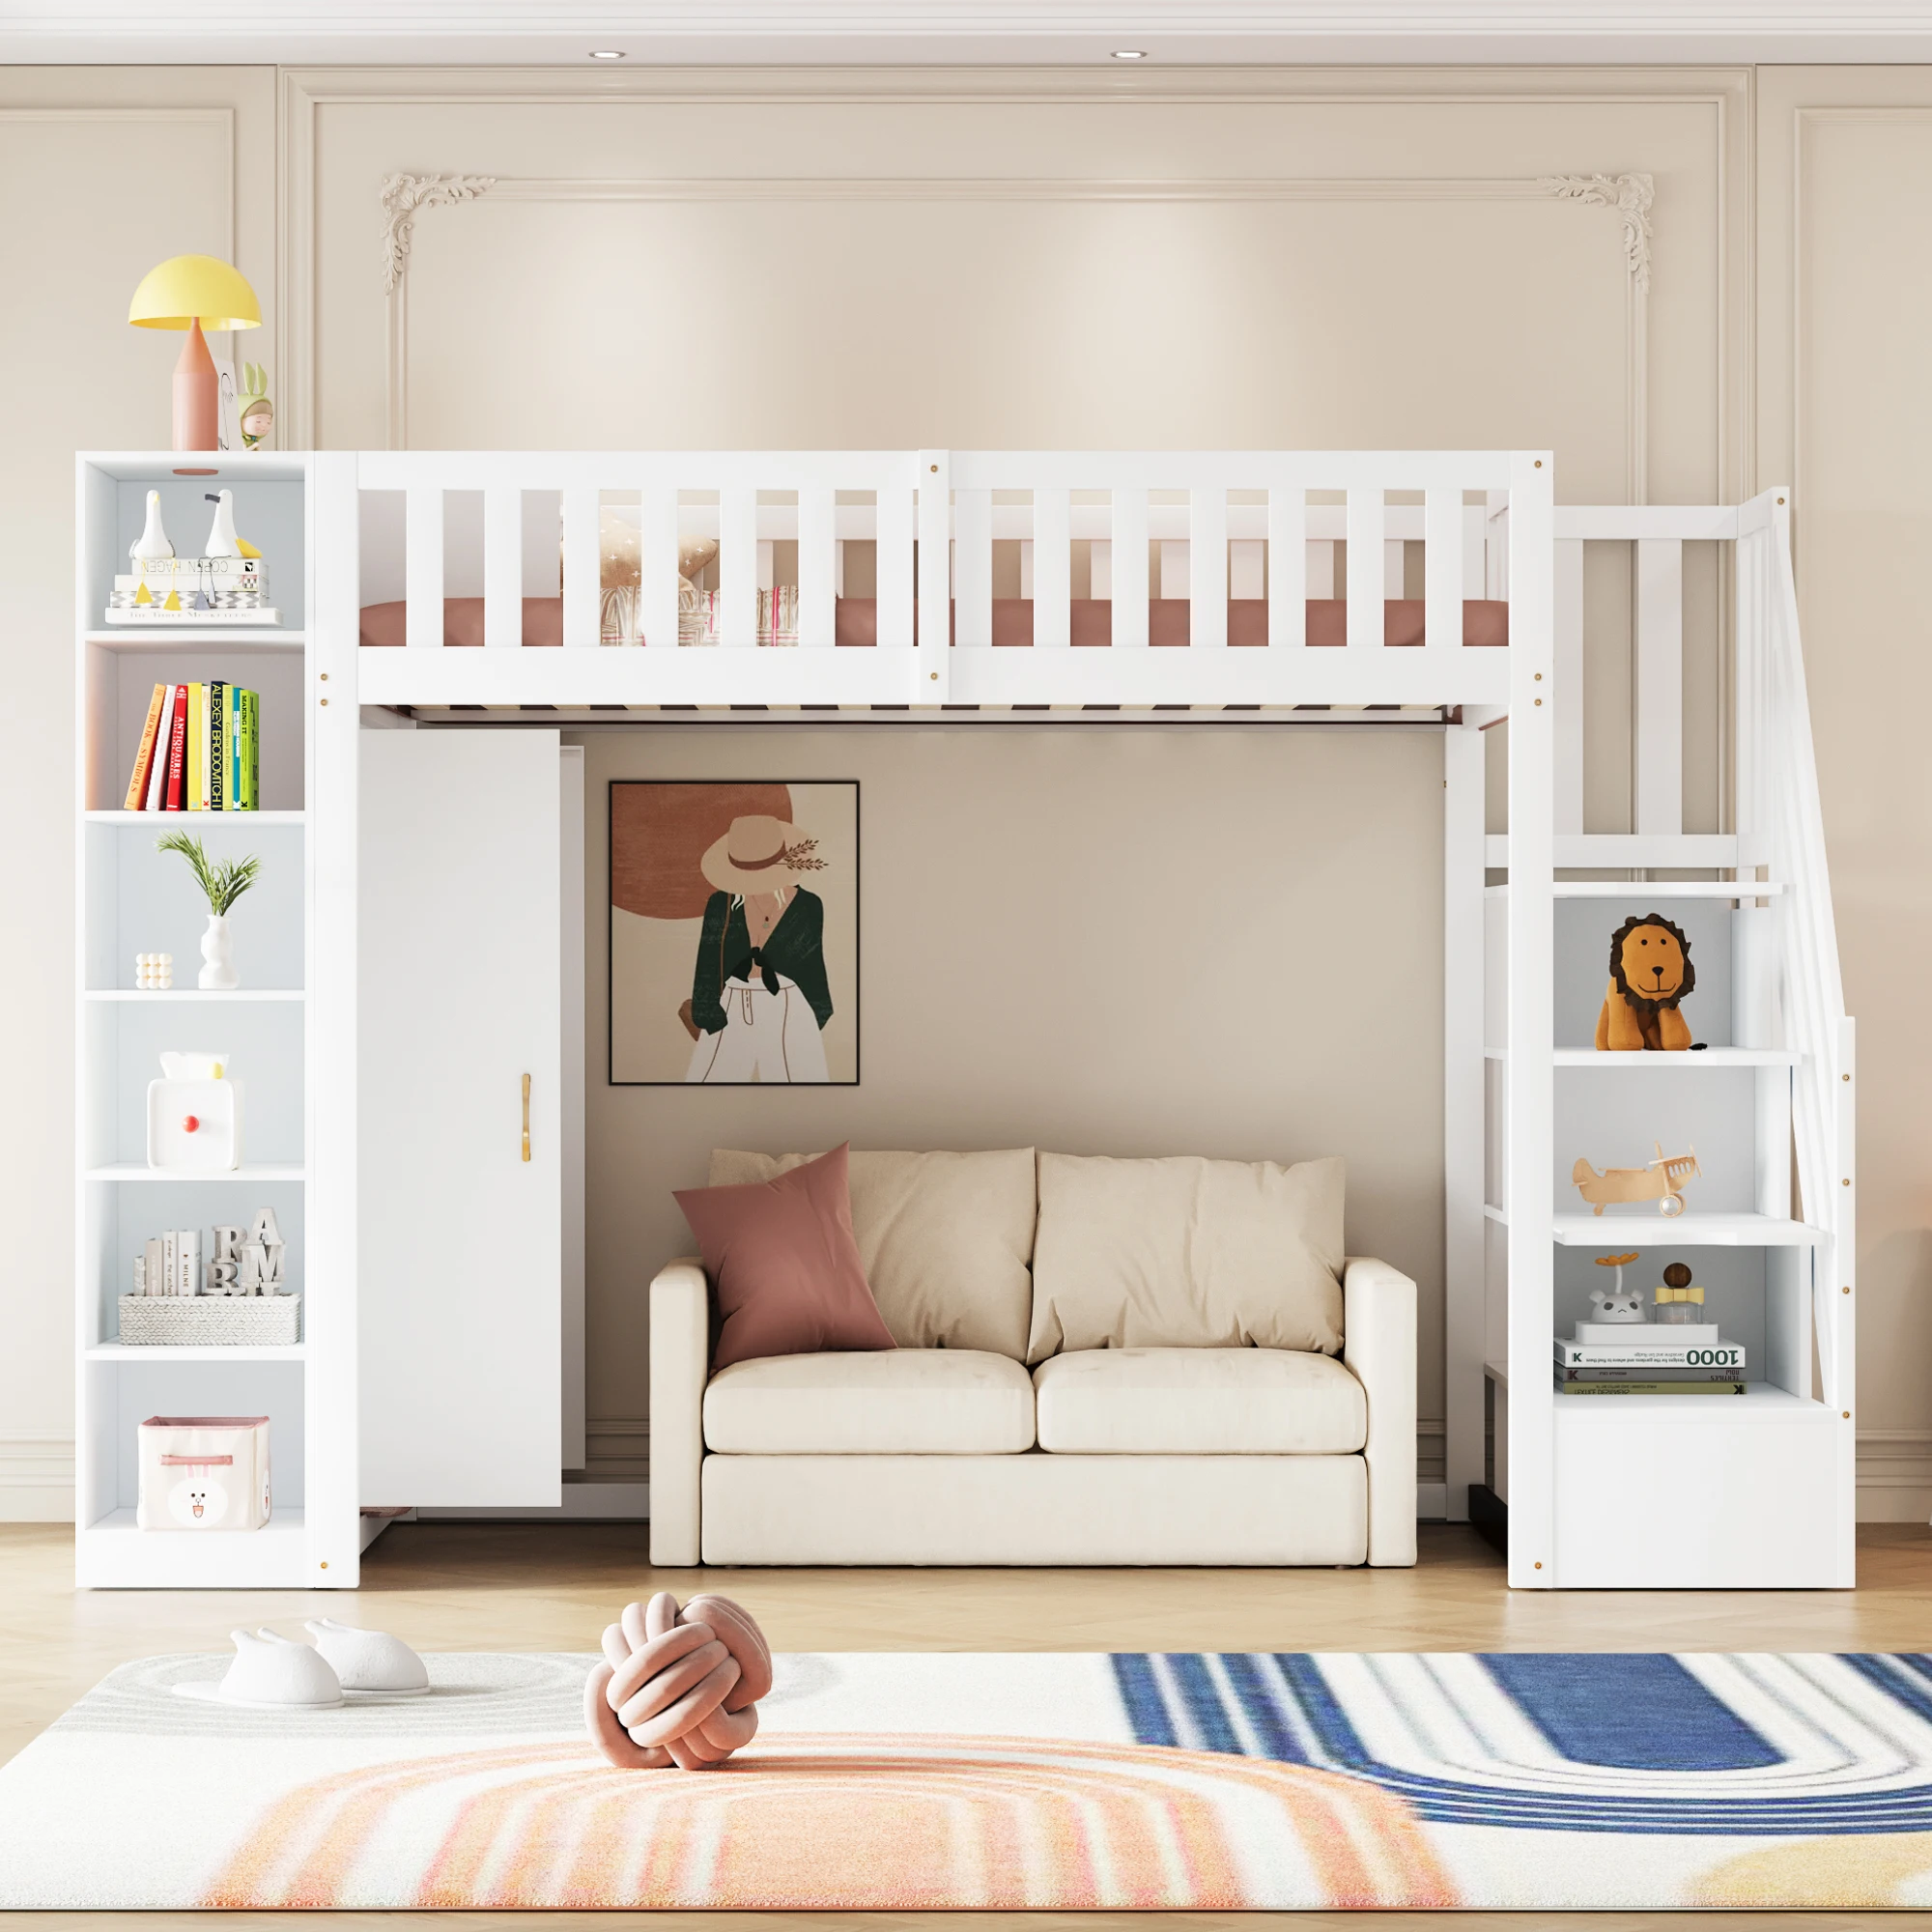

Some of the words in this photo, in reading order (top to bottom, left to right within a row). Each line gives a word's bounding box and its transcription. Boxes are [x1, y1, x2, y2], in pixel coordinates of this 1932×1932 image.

[144, 713, 156, 739] BOOK
[212, 684, 222, 727] ALEXEY
[130, 748, 148, 792] SYMBOLS
[173, 717, 185, 780] ANTIQUAIRES
[212, 729, 222, 802] BRODOVITCH
[1687, 1350, 1739, 1366] 1000
